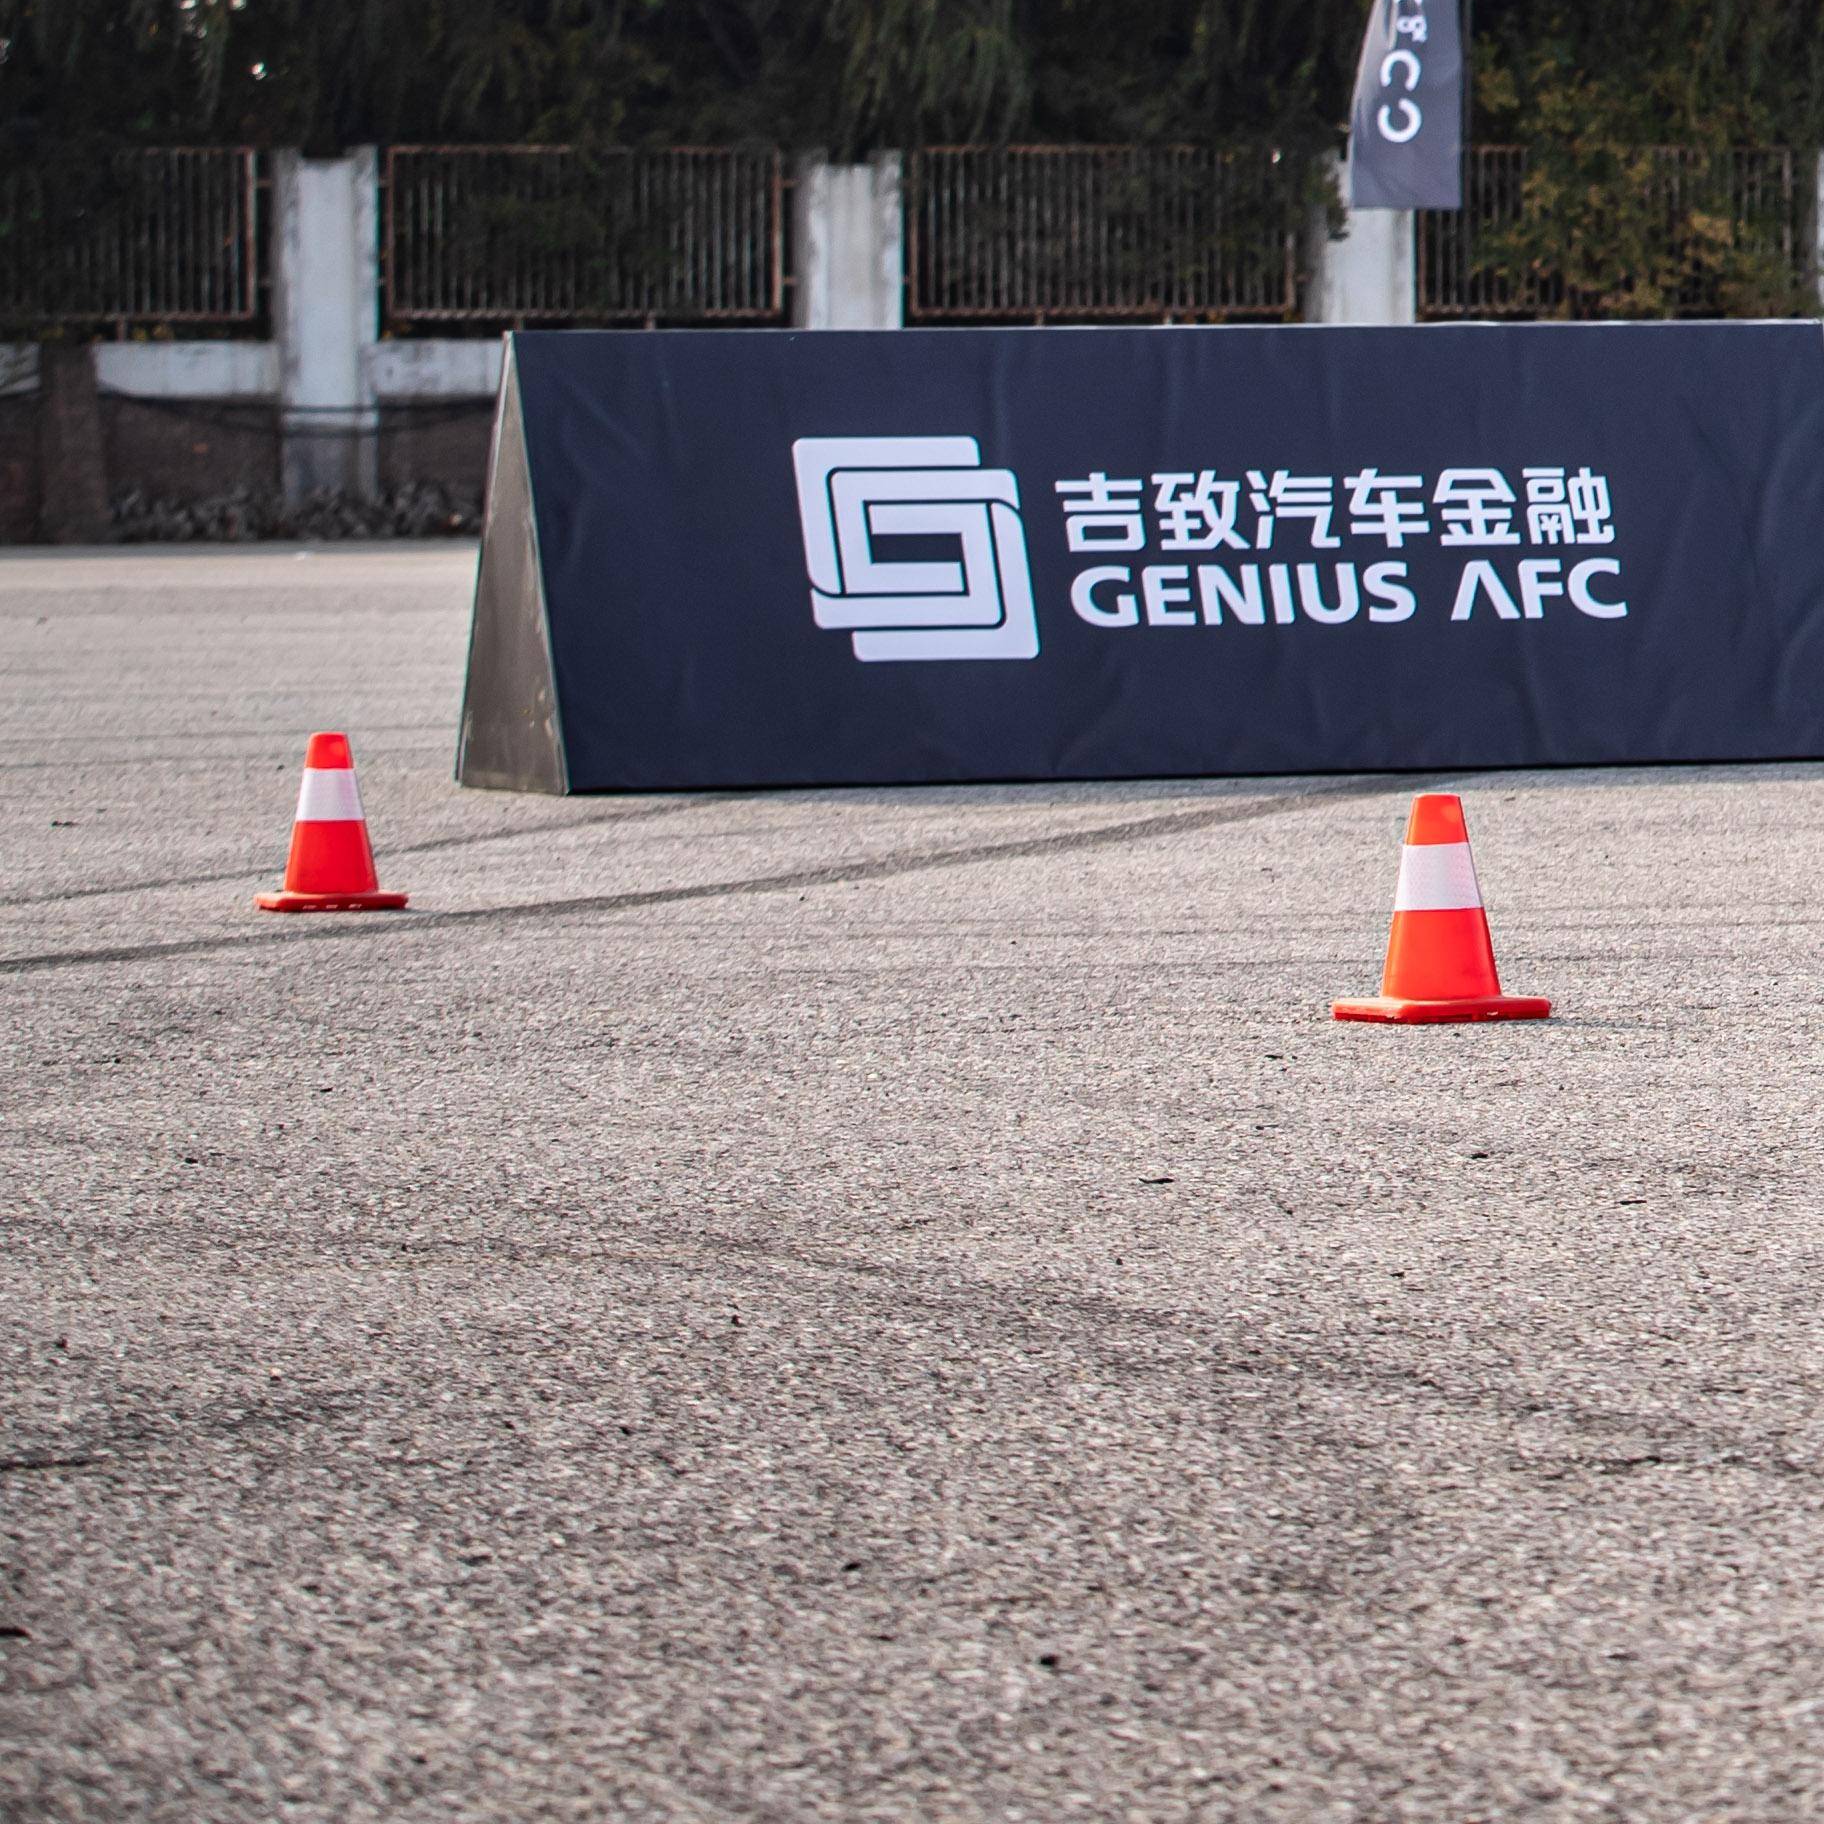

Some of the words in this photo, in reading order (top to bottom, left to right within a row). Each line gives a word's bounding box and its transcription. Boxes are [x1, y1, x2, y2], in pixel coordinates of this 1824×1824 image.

[1054, 467, 1615, 552] 吉致汽车金融
[1070, 561, 1415, 627] GENIUS
[1450, 558, 1627, 621] AFC
